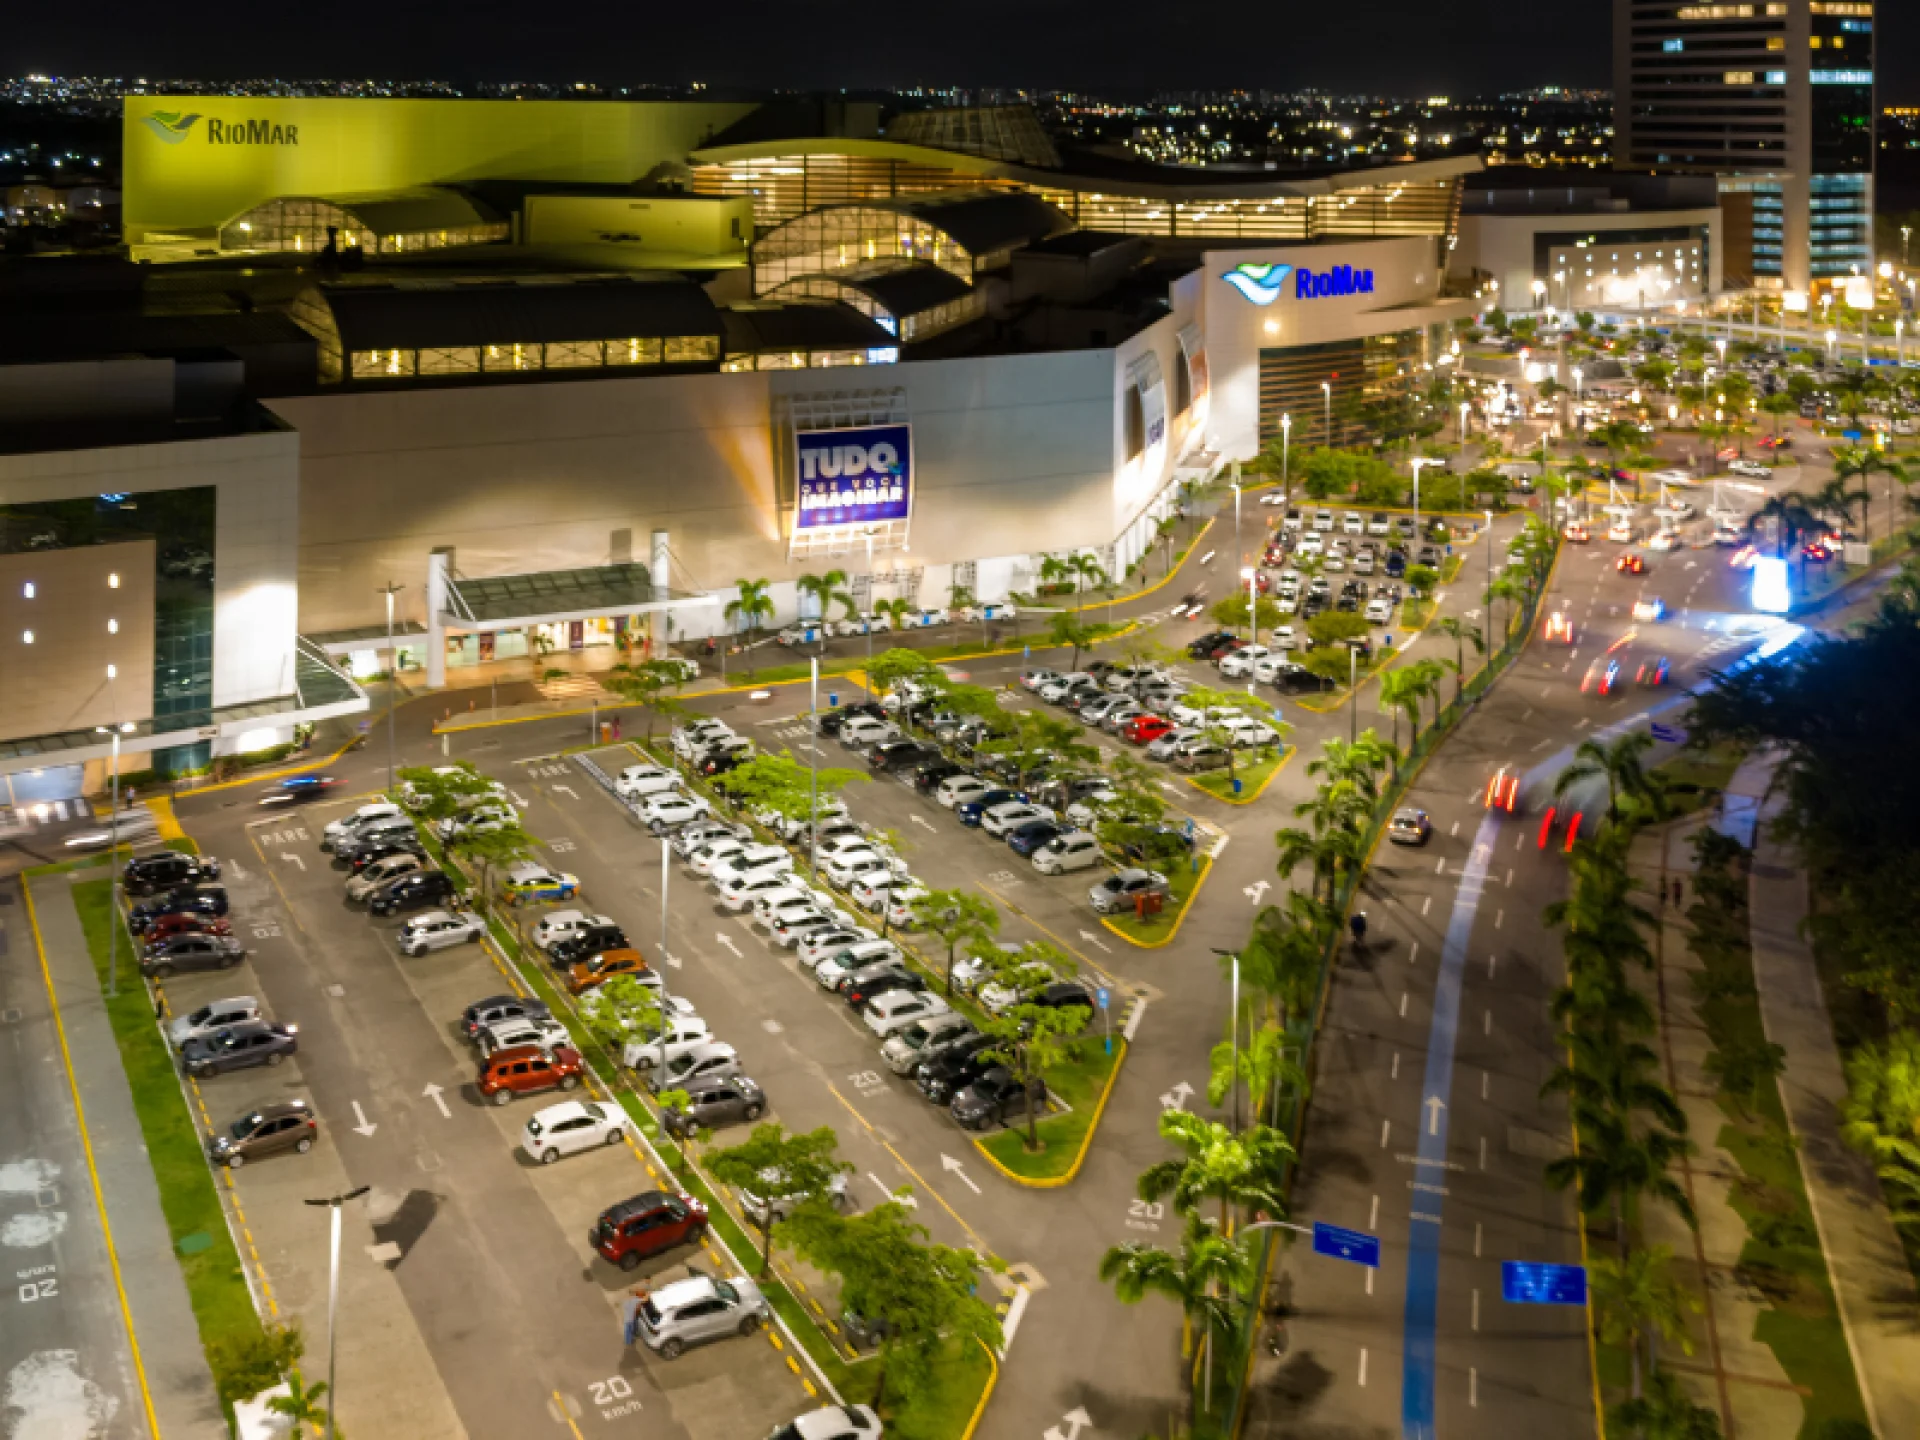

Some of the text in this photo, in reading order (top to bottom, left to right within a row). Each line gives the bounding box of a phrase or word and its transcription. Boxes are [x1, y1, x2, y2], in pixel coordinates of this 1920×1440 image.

[801, 442, 898, 479] TUDO
[262, 828, 309, 847] PARE
[1128, 1198, 1164, 1220] 20
[18, 1278, 59, 1303] 20
[587, 1375, 633, 1405] 20
